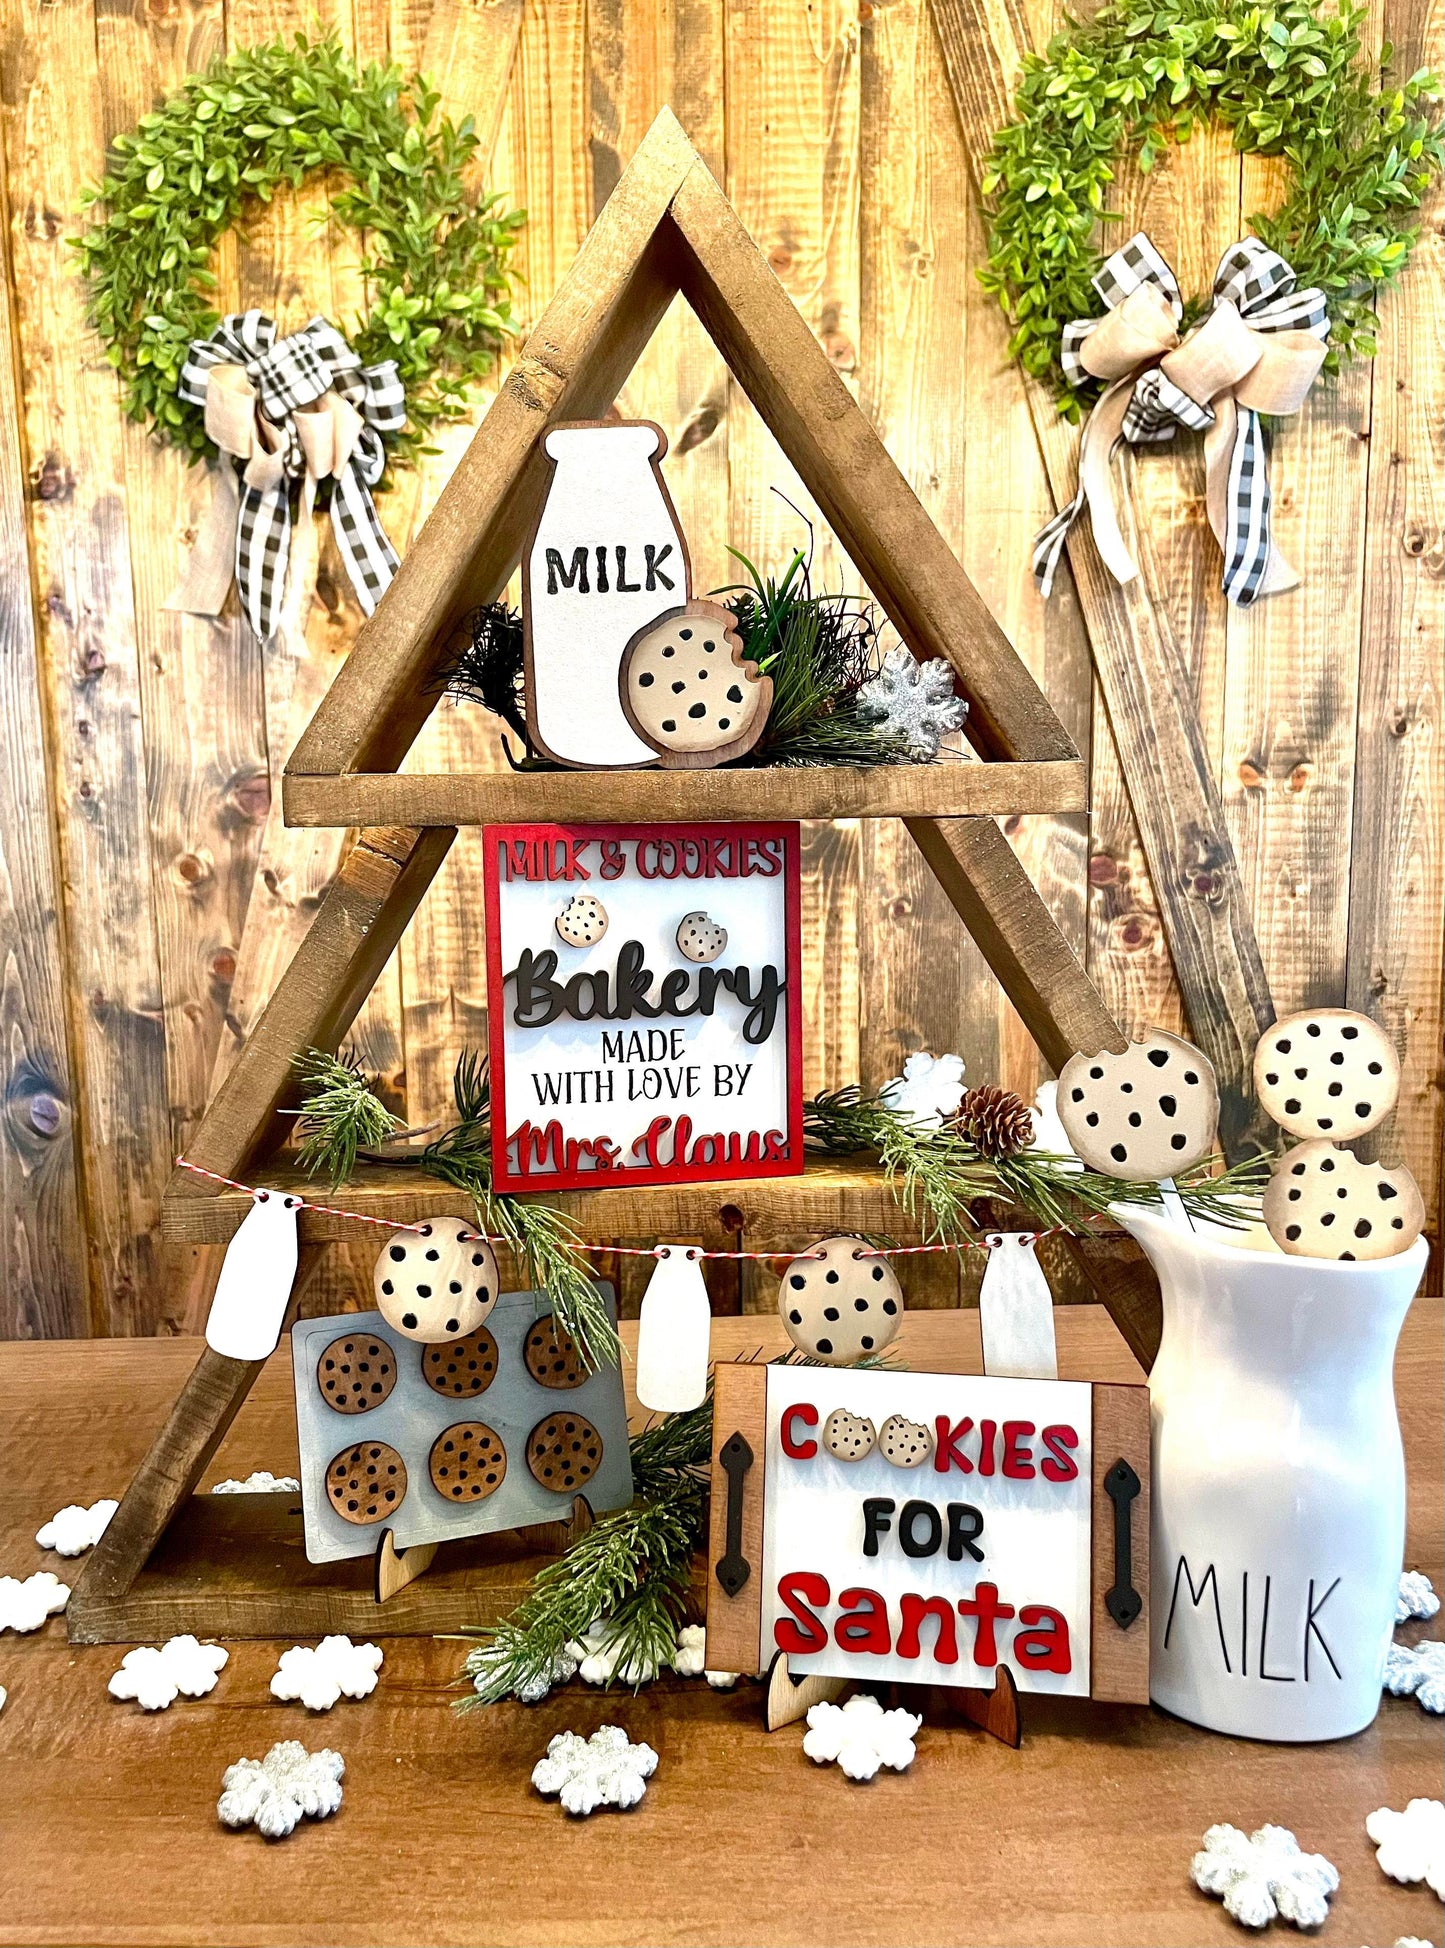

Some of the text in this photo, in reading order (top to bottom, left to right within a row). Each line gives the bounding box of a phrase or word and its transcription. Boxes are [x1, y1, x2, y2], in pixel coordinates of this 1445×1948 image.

[546, 544, 674, 594] MILK
[505, 838, 782, 882] MILK & COOKIES
[502, 940, 788, 1045] Bakery
[601, 1029, 686, 1063] MADE
[531, 1063, 753, 1105] WITH LOVE BY
[506, 1114, 790, 1175] Mrs. Claus
[862, 1497, 985, 1563] FOR
[774, 1571, 1072, 1674] Santa
[1164, 1555, 1342, 1683] MILK
